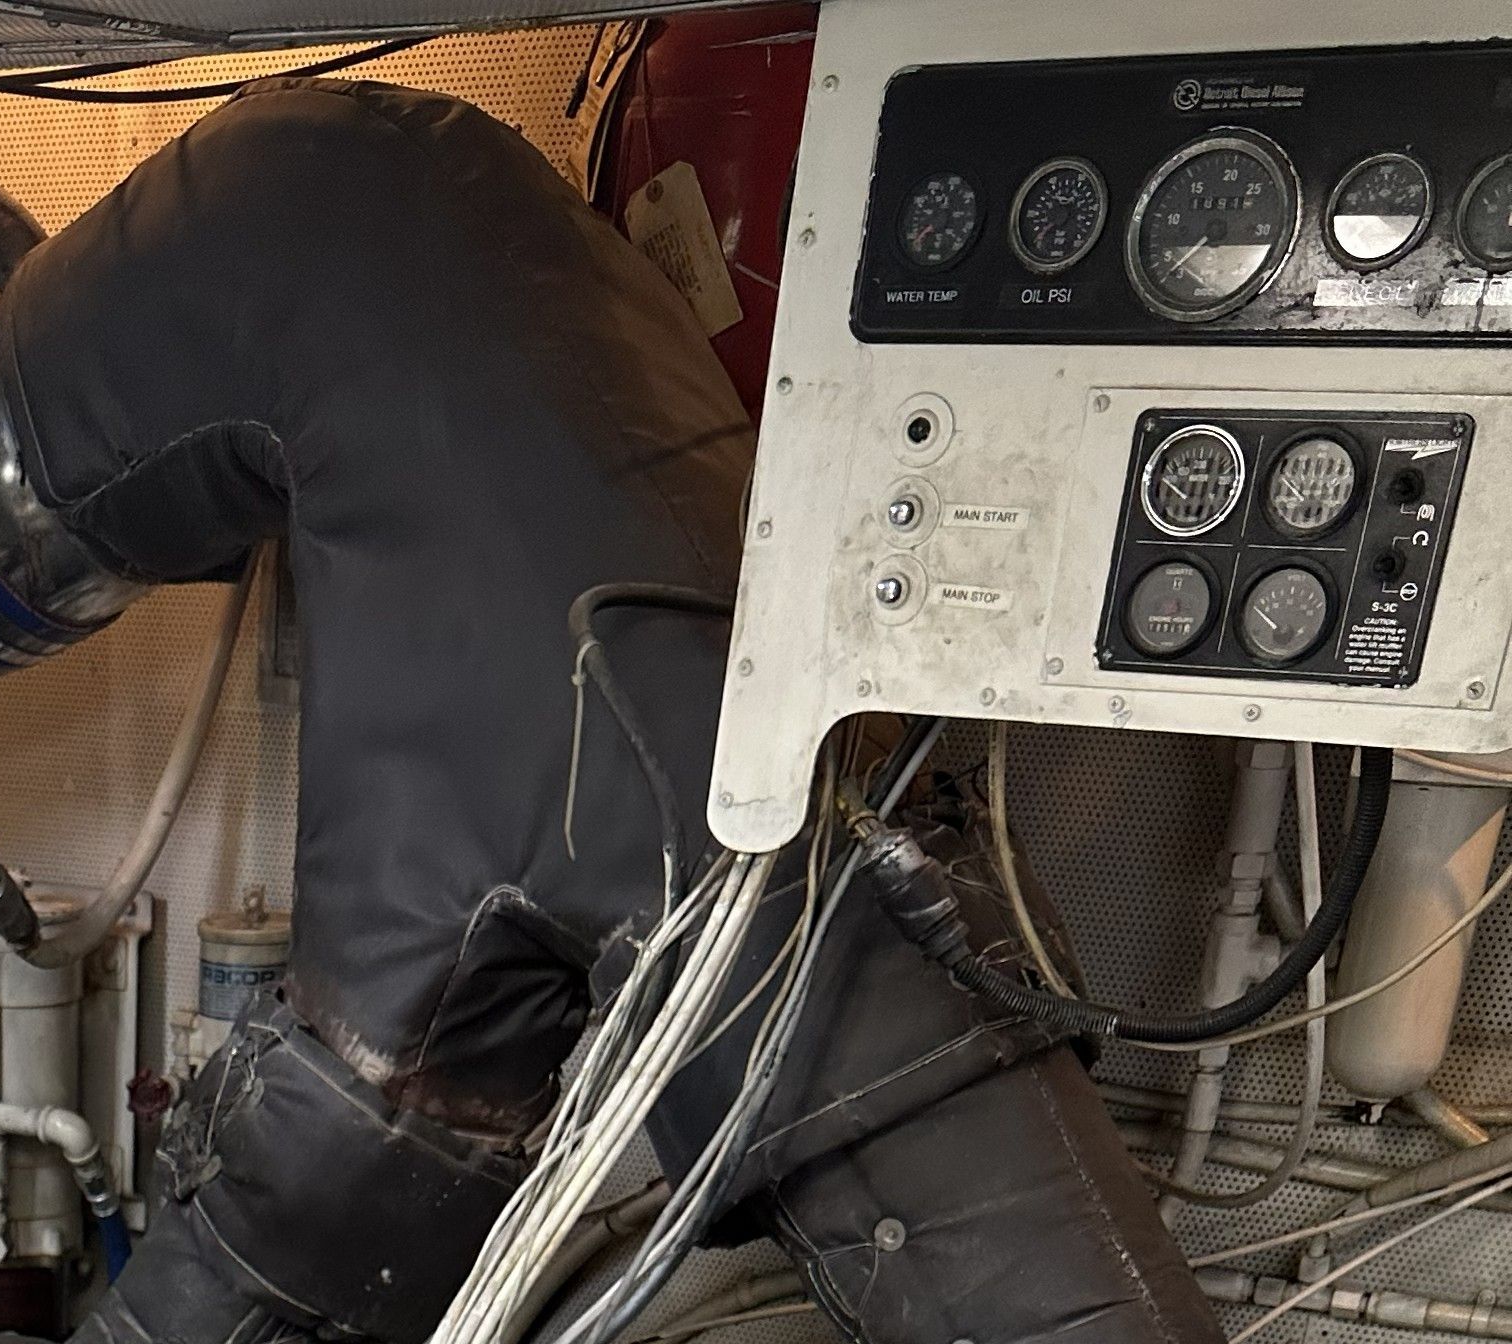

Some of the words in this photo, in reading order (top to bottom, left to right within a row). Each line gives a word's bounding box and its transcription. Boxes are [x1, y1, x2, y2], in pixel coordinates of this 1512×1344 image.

[1223, 169, 1239, 182] 20
[1190, 181, 1205, 194] 15
[1245, 182, 1262, 195] 25
[1167, 213, 1181, 226] 10
[1254, 223, 1271, 236] 30
[886, 291, 924, 303] WATER
[926, 290, 958, 302] TEMP
[1021, 288, 1044, 304] OIL
[1048, 287, 1072, 303] PSI
[953, 509, 981, 521] MAIN
[982, 511, 1019, 523] START
[942, 587, 969, 601] MAIN
[970, 591, 1001, 604] STOP
[1371, 601, 1399, 613] S-3C
